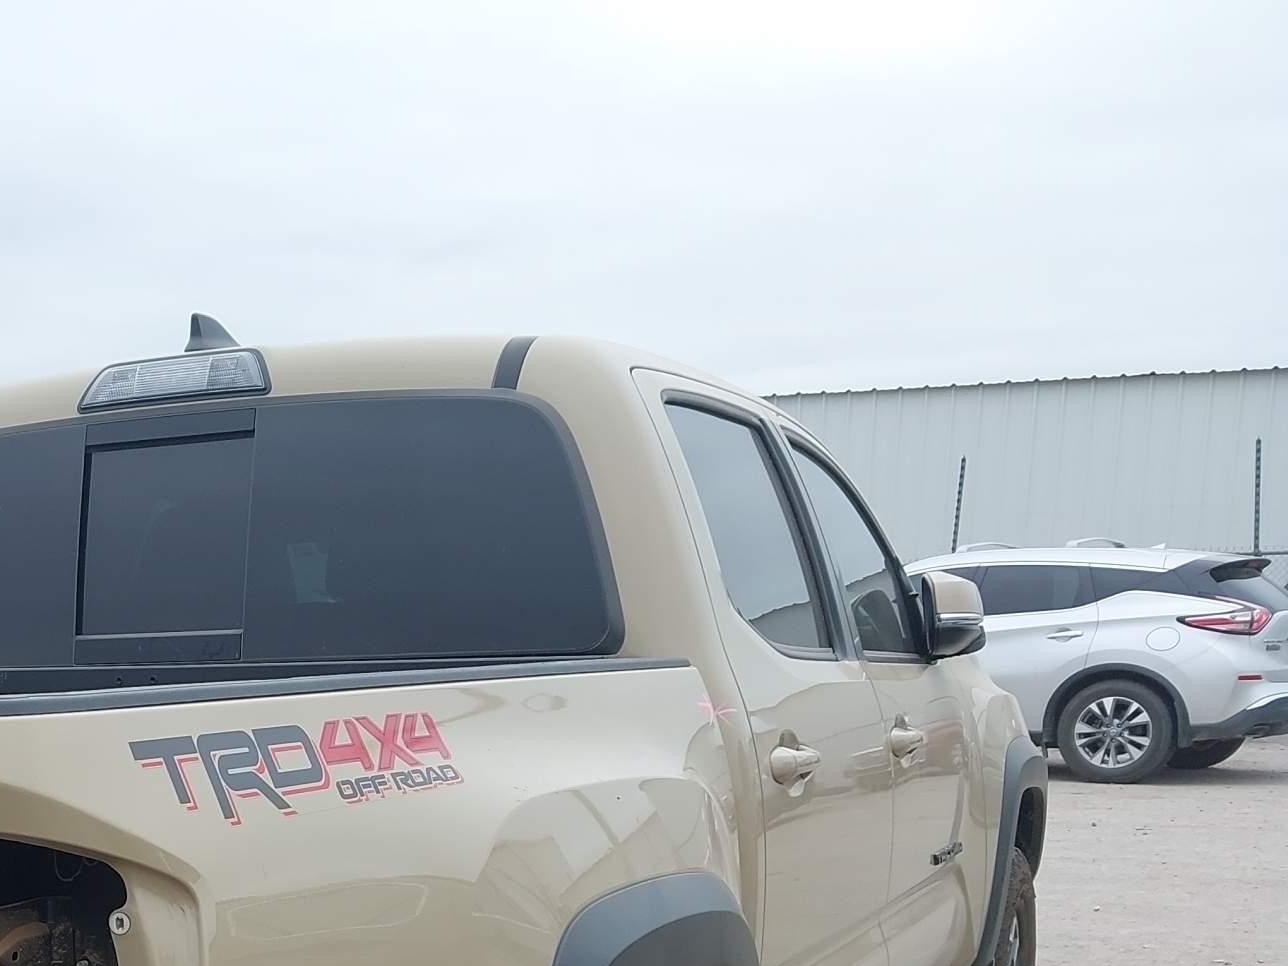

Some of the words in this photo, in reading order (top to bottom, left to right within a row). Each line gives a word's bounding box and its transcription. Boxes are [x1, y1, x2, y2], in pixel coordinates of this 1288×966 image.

[128, 724, 331, 827] TRD
[318, 712, 453, 772] 4X4
[335, 773, 390, 804] OFF
[390, 763, 464, 795] ROAD
